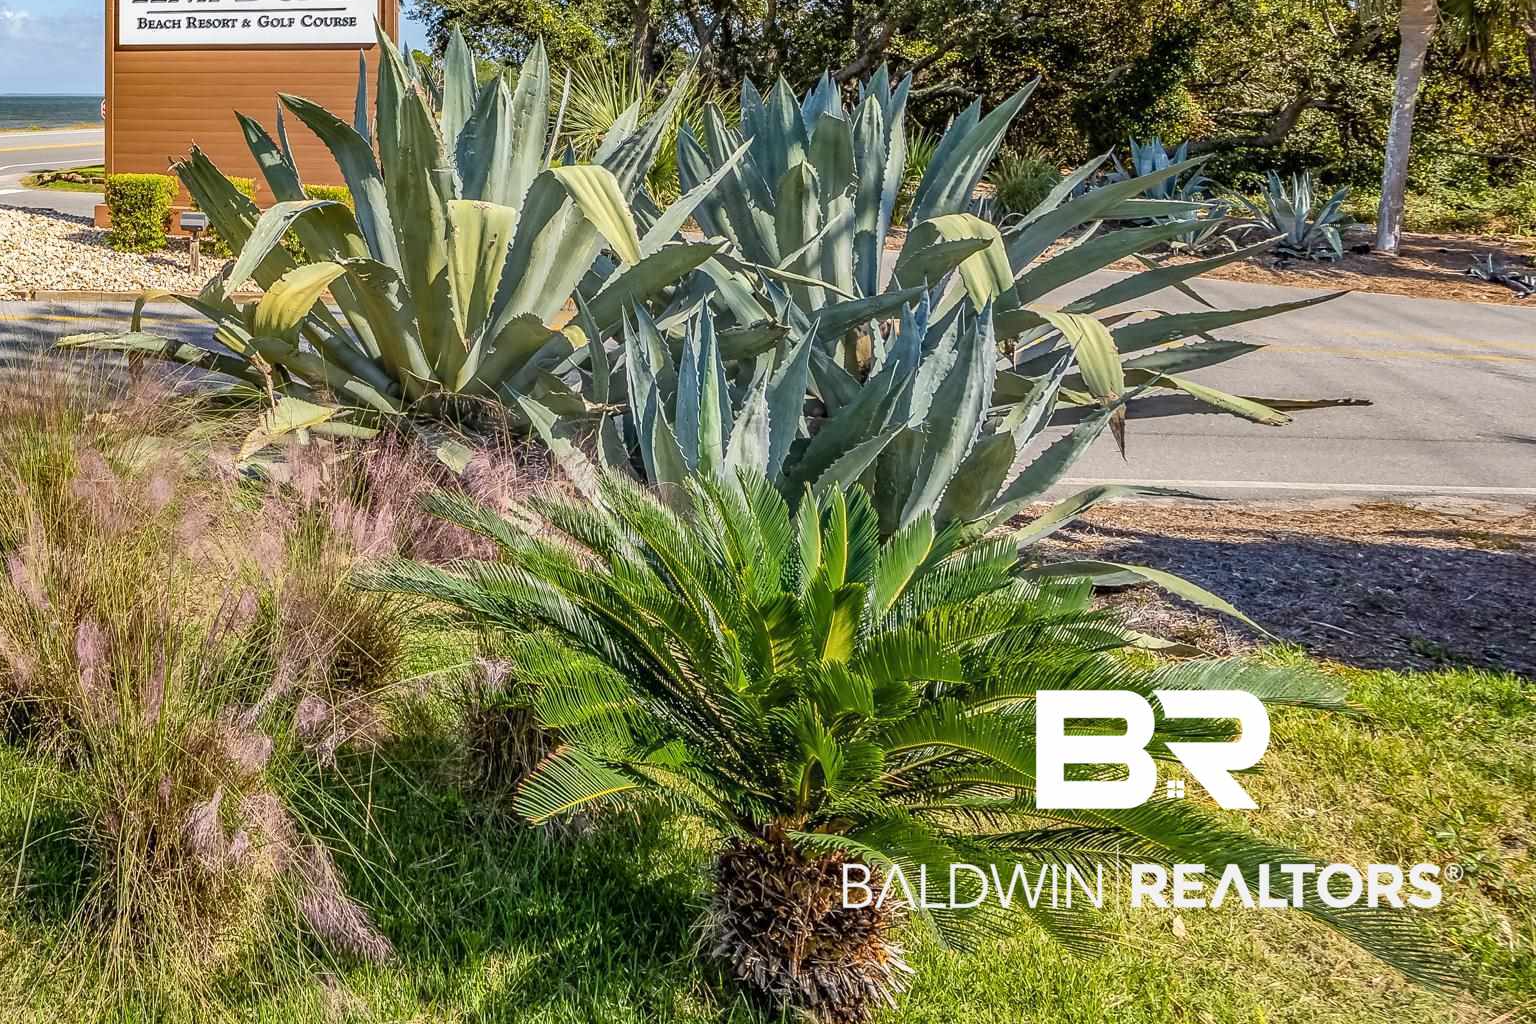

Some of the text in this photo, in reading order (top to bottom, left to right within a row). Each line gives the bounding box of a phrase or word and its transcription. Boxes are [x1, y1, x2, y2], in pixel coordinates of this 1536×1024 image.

[137, 14, 358, 30] BEACH RESORT & GOLF COURSE
